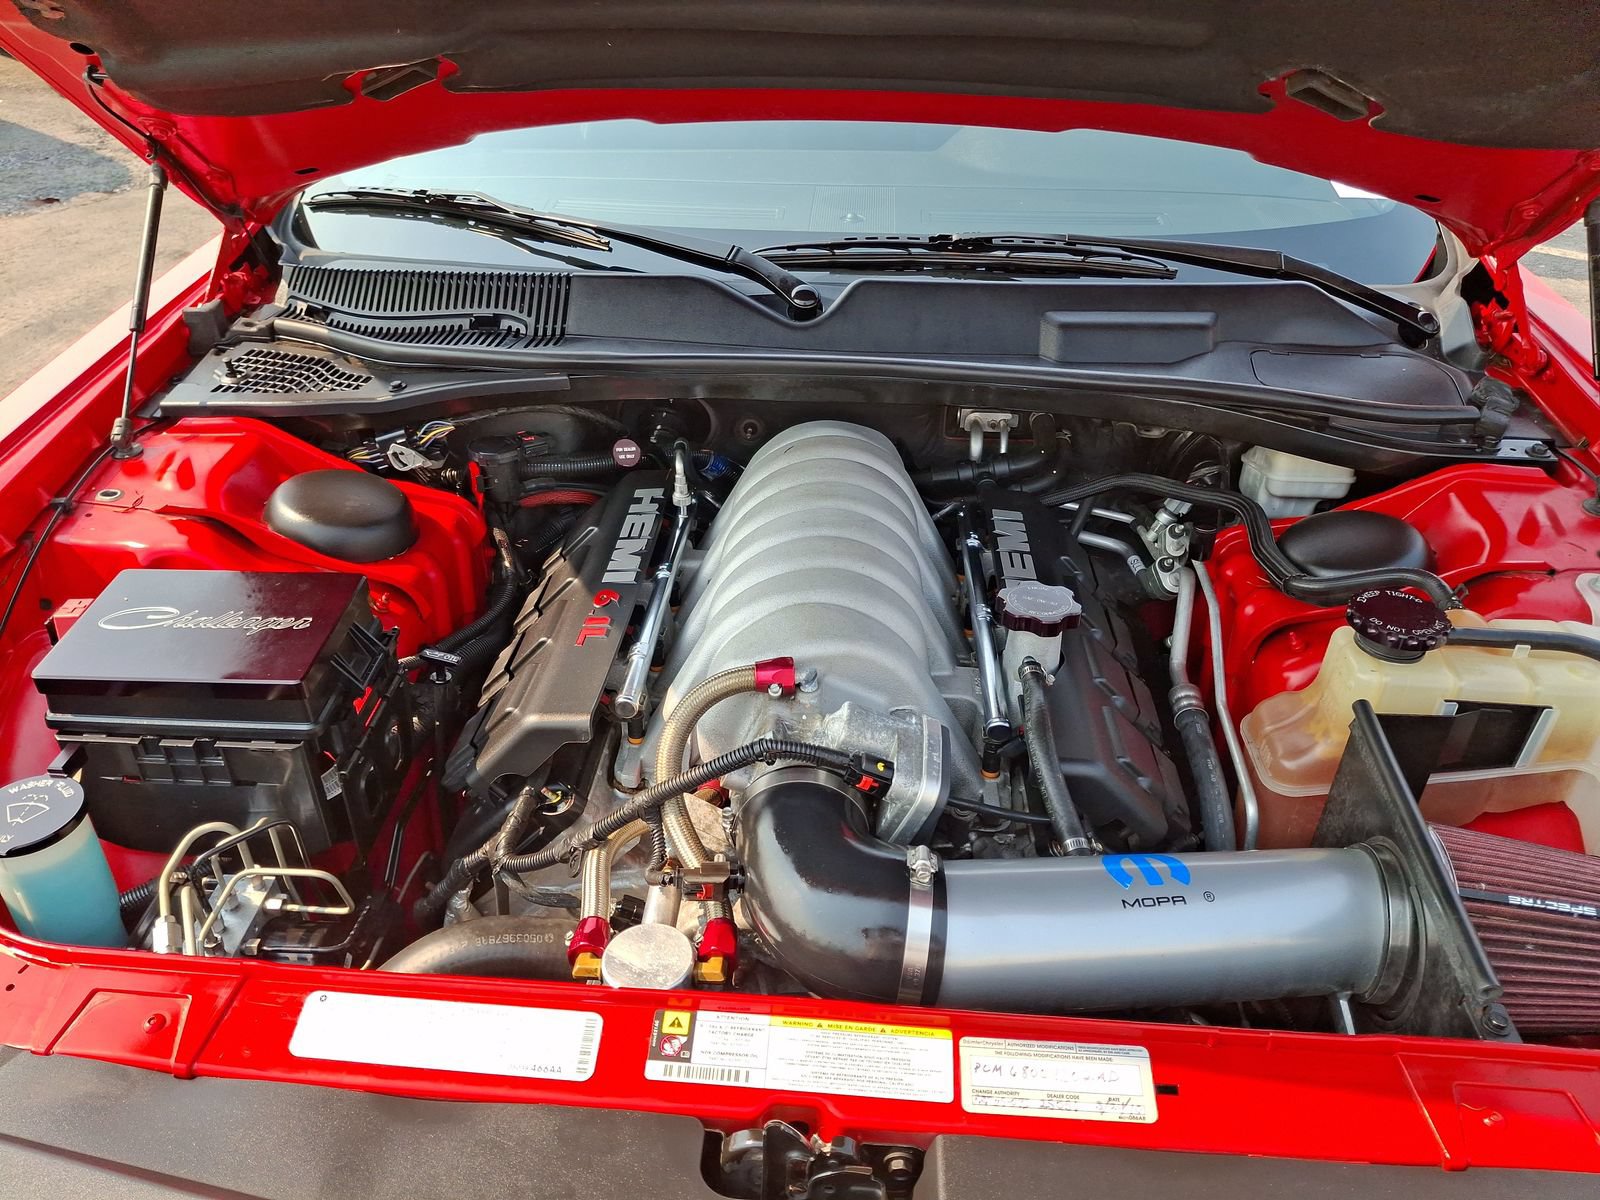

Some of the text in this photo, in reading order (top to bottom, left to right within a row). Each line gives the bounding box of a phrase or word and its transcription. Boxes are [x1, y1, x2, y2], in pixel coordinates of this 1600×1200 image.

[602, 487, 665, 584] HEMI
[98, 606, 313, 636] Challenger
[1369, 617, 1383, 626] DO
[1386, 624, 1407, 634] NOT
[8, 779, 54, 794] WASHER
[1507, 895, 1598, 916] SPECTRE
[782, 1020, 814, 1028] WARNING
[890, 1028, 935, 1037] ADVERTENCIA
[1007, 1042, 1036, 1050] AUTHORIZED
